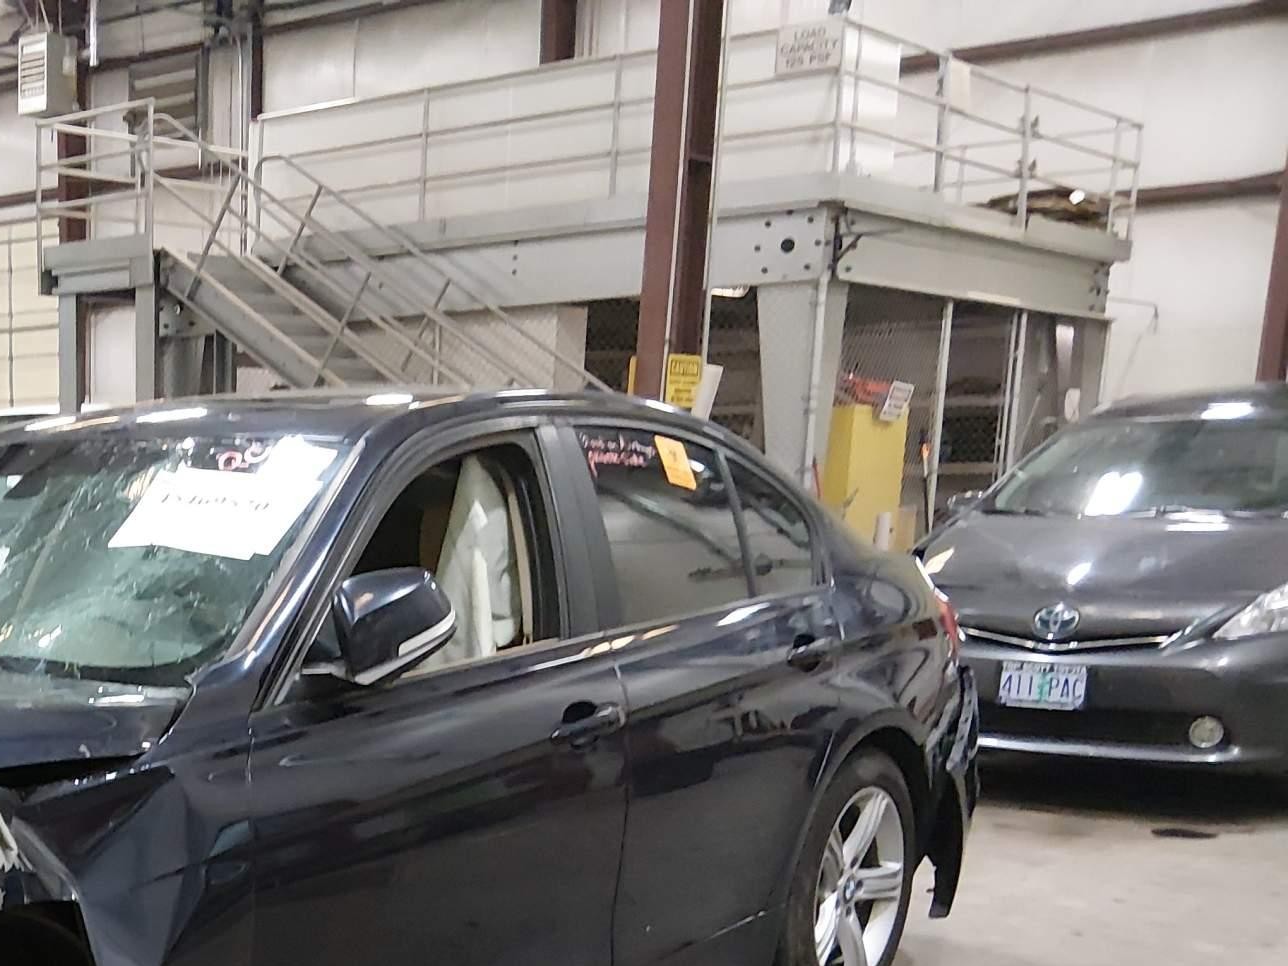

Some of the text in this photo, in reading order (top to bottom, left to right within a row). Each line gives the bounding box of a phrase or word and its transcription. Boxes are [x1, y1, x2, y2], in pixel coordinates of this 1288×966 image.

[793, 26, 827, 40] LOAD
[780, 39, 839, 55] CAPACITY
[1047, 676, 1083, 701] PAC
